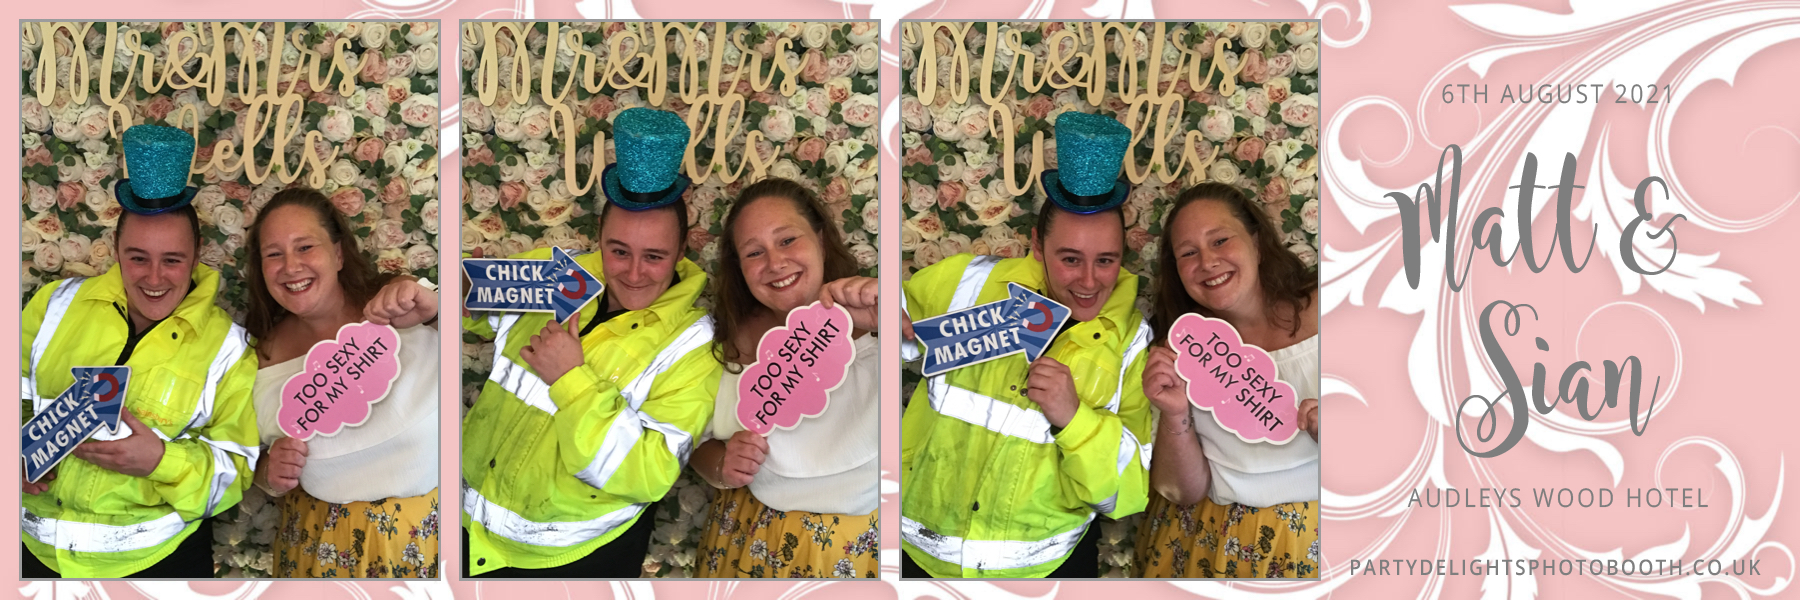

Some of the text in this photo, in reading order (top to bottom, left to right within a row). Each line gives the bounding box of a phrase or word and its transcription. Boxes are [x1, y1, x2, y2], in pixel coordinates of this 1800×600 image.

[550, 93, 781, 196] Wlls
[988, 93, 1220, 196] Wlls
[477, 287, 554, 305] MAGNET
[485, 264, 544, 283] CHICK
[934, 326, 1022, 366] MAGNET
[939, 306, 1006, 338] CHICK
[293, 336, 360, 405] TOO SEXY
[296, 336, 388, 431] FOR MY SHIRT
[749, 320, 811, 398] TOO SEXY
[755, 318, 840, 425] FOR MY SHIRT
[1179, 333, 1284, 432] FOR MY SHIRT
[1206, 332, 1283, 403] TOO SEXY
[28, 392, 80, 441] CHICK
[31, 403, 99, 470] MAGNET
